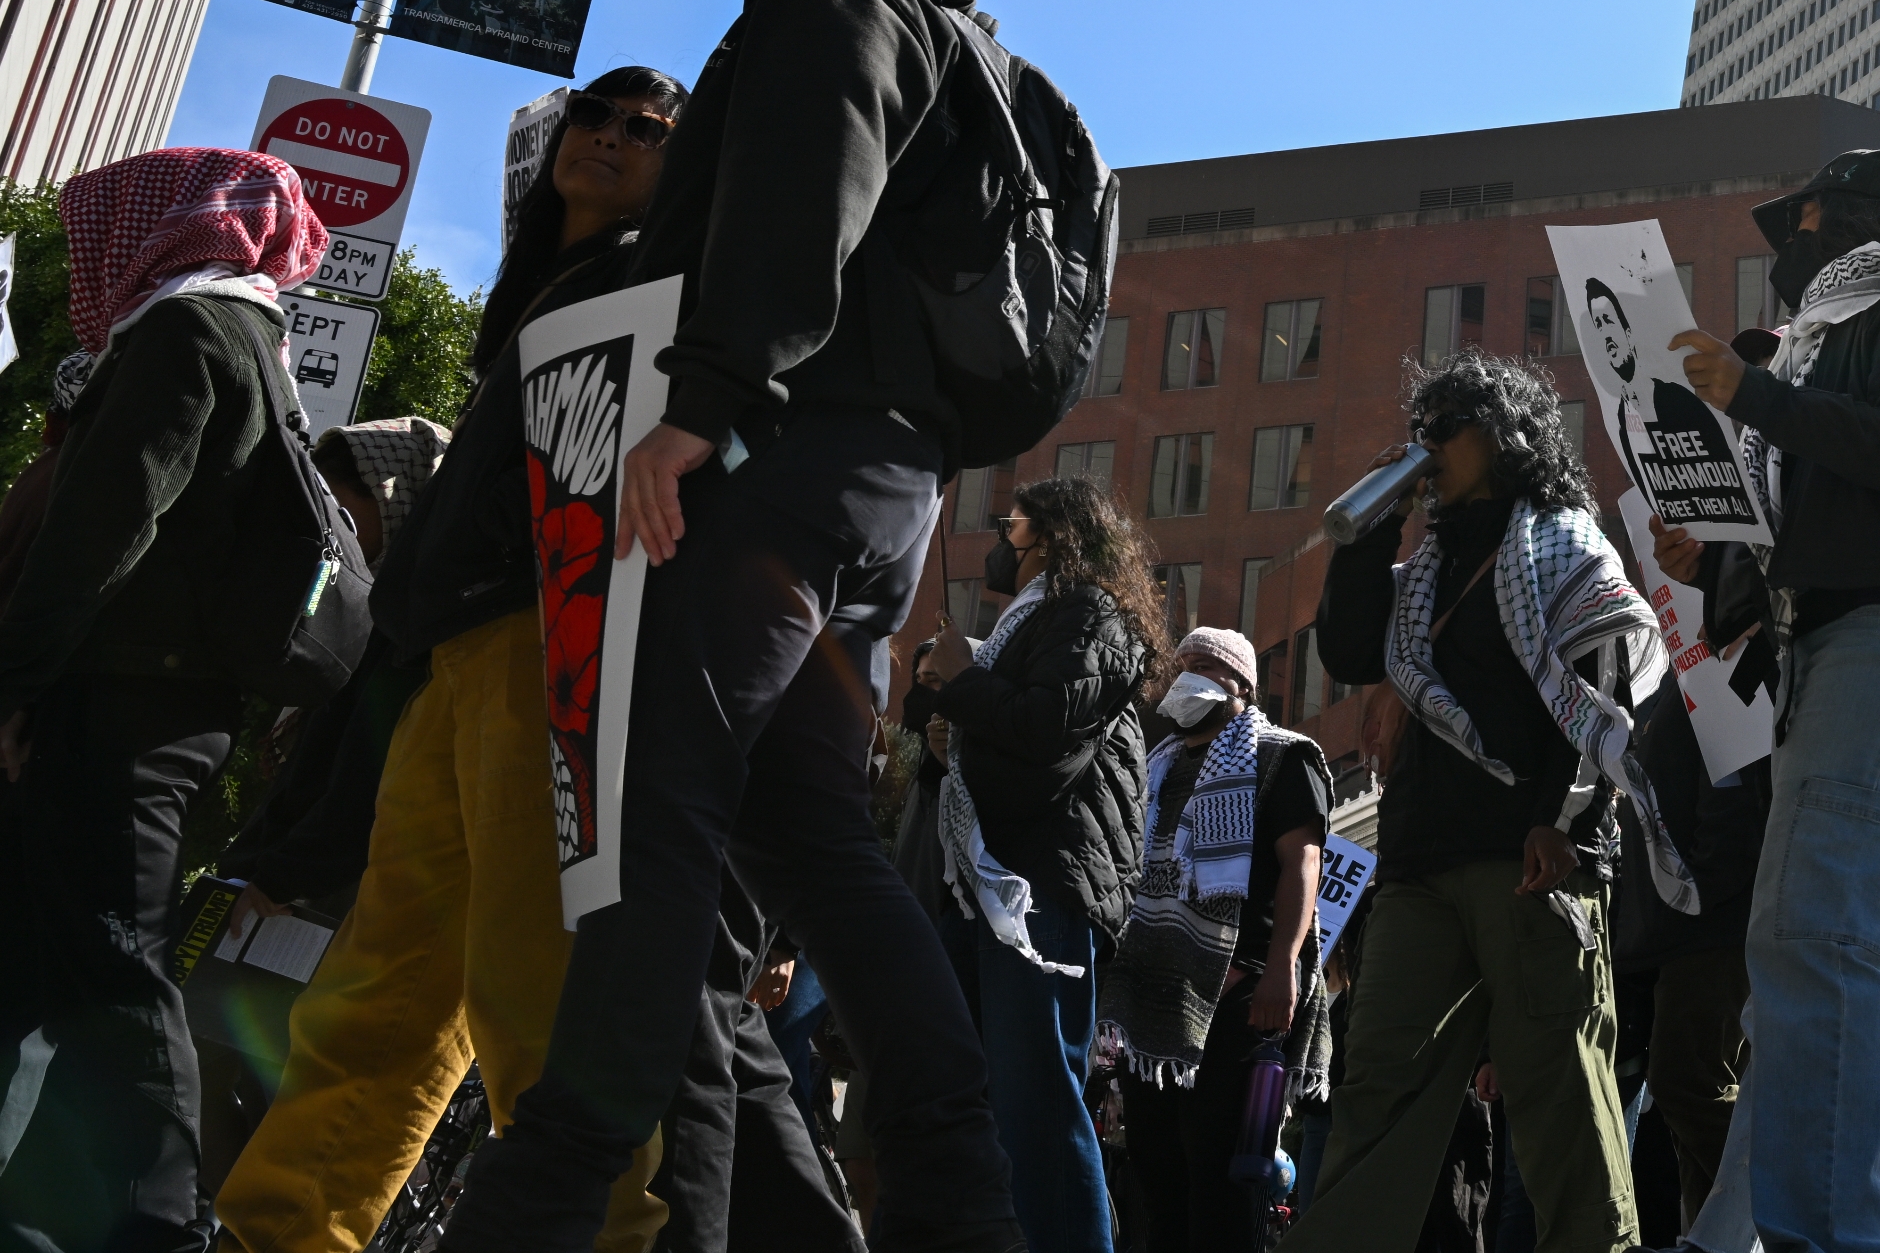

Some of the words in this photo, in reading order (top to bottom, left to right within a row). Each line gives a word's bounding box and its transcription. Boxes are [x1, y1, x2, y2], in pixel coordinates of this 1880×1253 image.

[403, 7, 481, 33] TRANSAMERICA
[485, 26, 529, 44] PYRAMID
[531, 38, 571, 55] CENTER
[295, 116, 332, 140] DO
[338, 126, 390, 153] NOT
[301, 178, 369, 210] NTER
[284, 309, 346, 341] EPT
[524, 353, 621, 496] AHMOUD
[1651, 430, 1709, 460] FREE
[1644, 461, 1741, 491] MAHMOUD
[1657, 499, 1696, 519] FREE
[1691, 497, 1731, 516] THEM
[1667, 607, 1679, 627] IN
[1673, 640, 1712, 675] PALESTI
[1323, 848, 1367, 887] PLE
[186, 889, 236, 949] TRUMP
